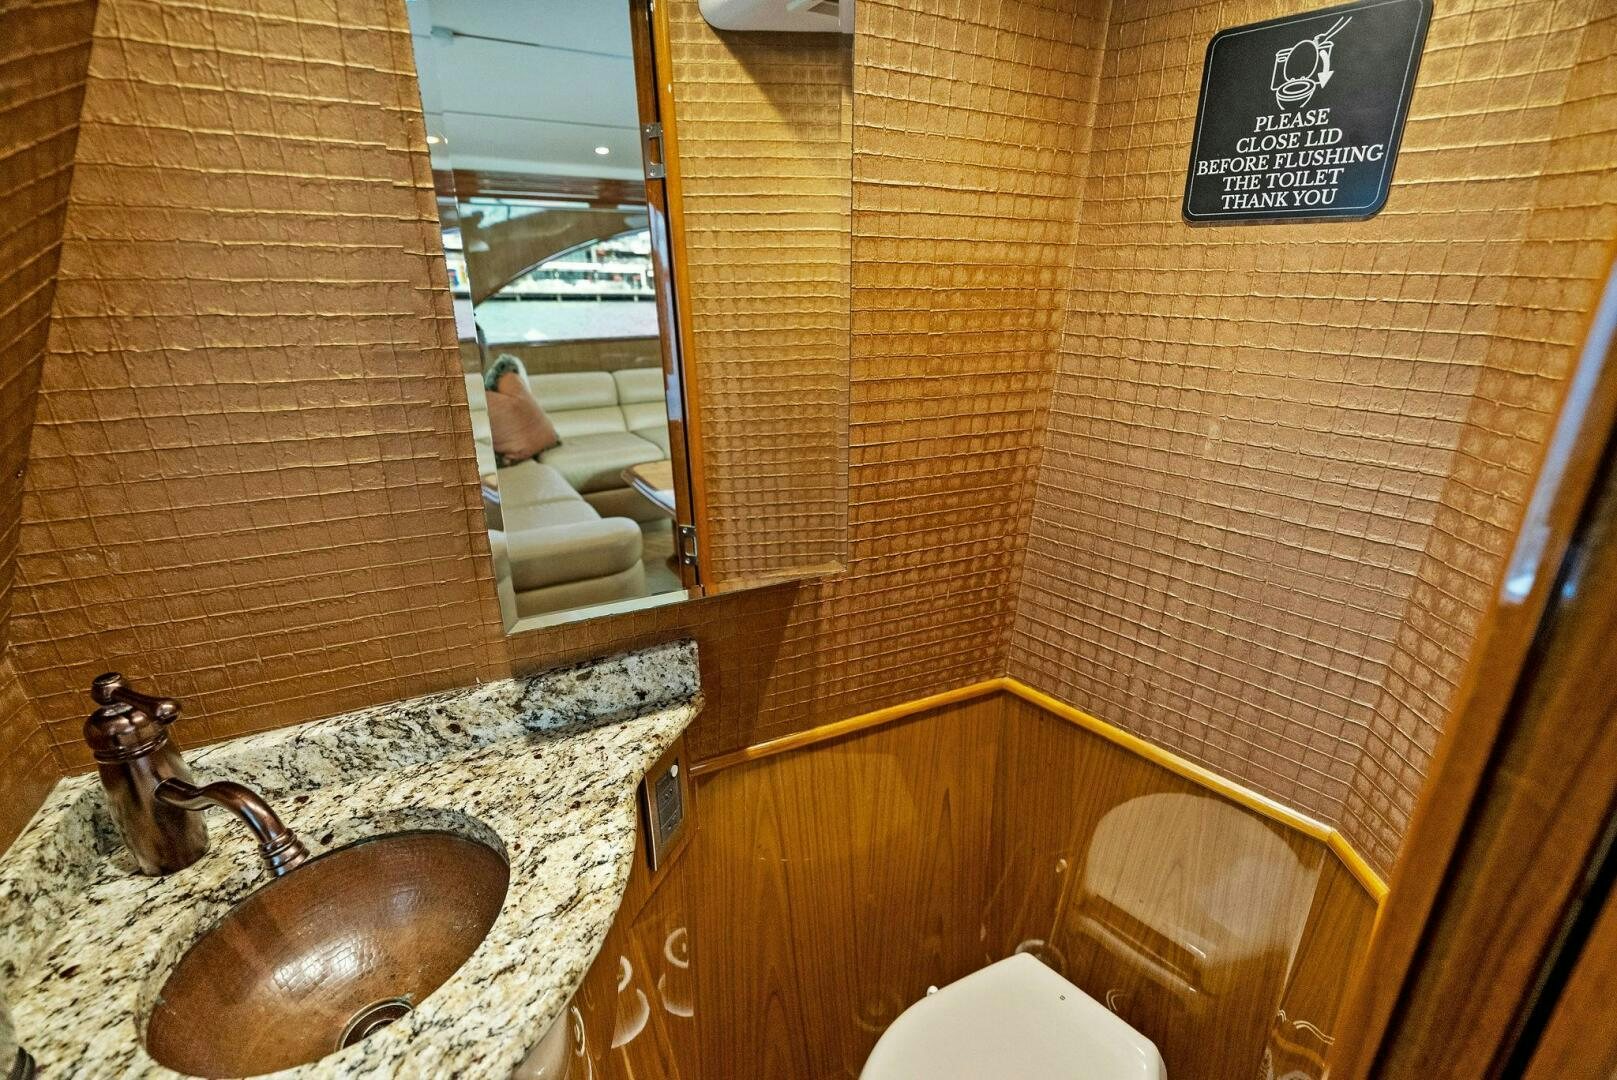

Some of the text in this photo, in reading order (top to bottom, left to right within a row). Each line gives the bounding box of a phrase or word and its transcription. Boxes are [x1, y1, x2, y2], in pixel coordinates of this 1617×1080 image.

[1254, 108, 1331, 132] PLEASE
[1236, 128, 1343, 154] CLOSE LID
[1196, 144, 1384, 176] BEFORE FLUSHING
[1223, 168, 1344, 192] THE TOILET
[1221, 188, 1338, 210] THANK YOU
